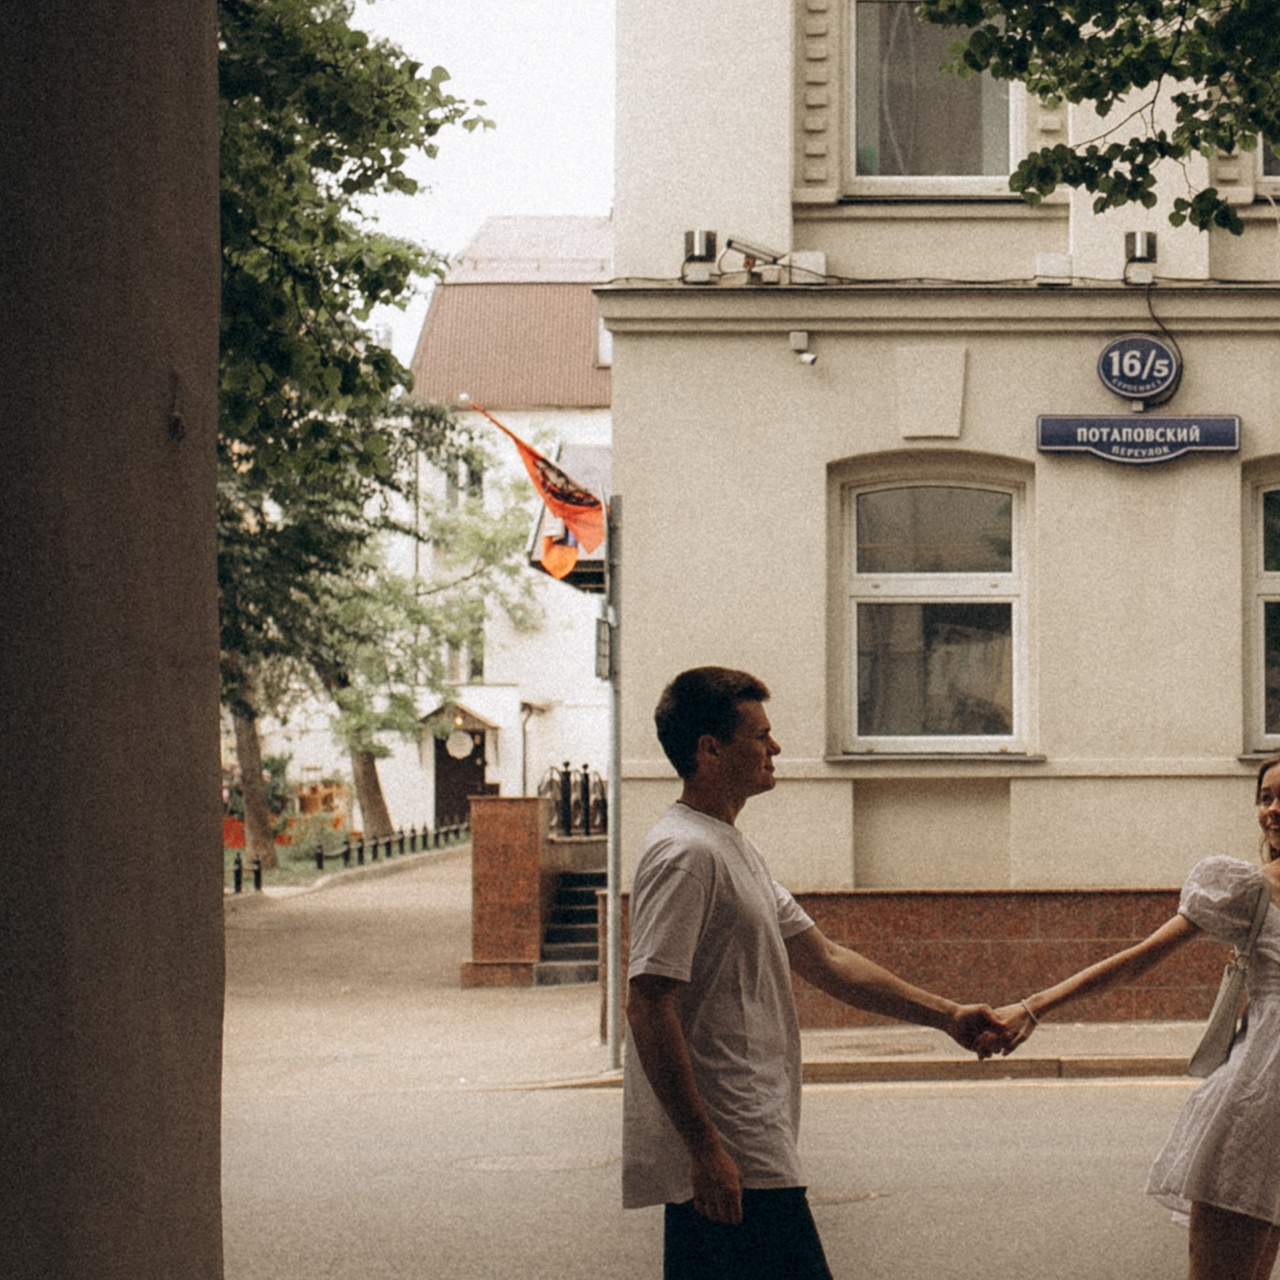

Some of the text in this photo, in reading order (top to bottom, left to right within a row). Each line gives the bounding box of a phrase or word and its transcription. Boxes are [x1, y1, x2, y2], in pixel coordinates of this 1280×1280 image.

[1108, 349, 1170, 380] 16/5
[1076, 425, 1200, 442] ПОТАПОВСКИЙ
[1111, 446, 1170, 457] ПЕРЕУЛОК
